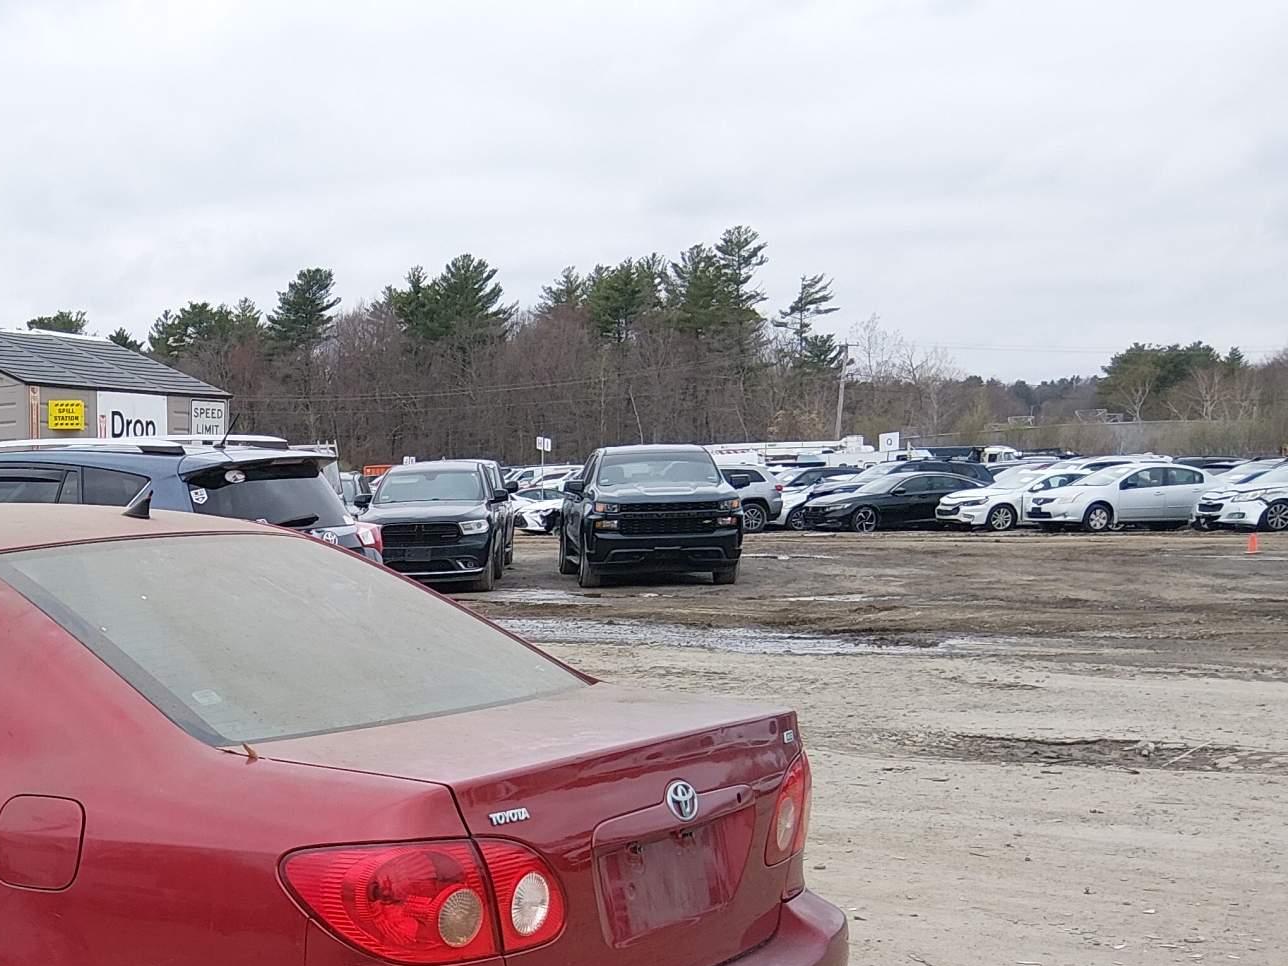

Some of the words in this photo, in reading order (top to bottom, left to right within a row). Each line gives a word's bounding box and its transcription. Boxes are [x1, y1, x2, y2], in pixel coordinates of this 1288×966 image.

[193, 407, 223, 419] SPEED
[196, 423, 220, 436] LIMIT
[489, 808, 530, 826] TOYOTA
